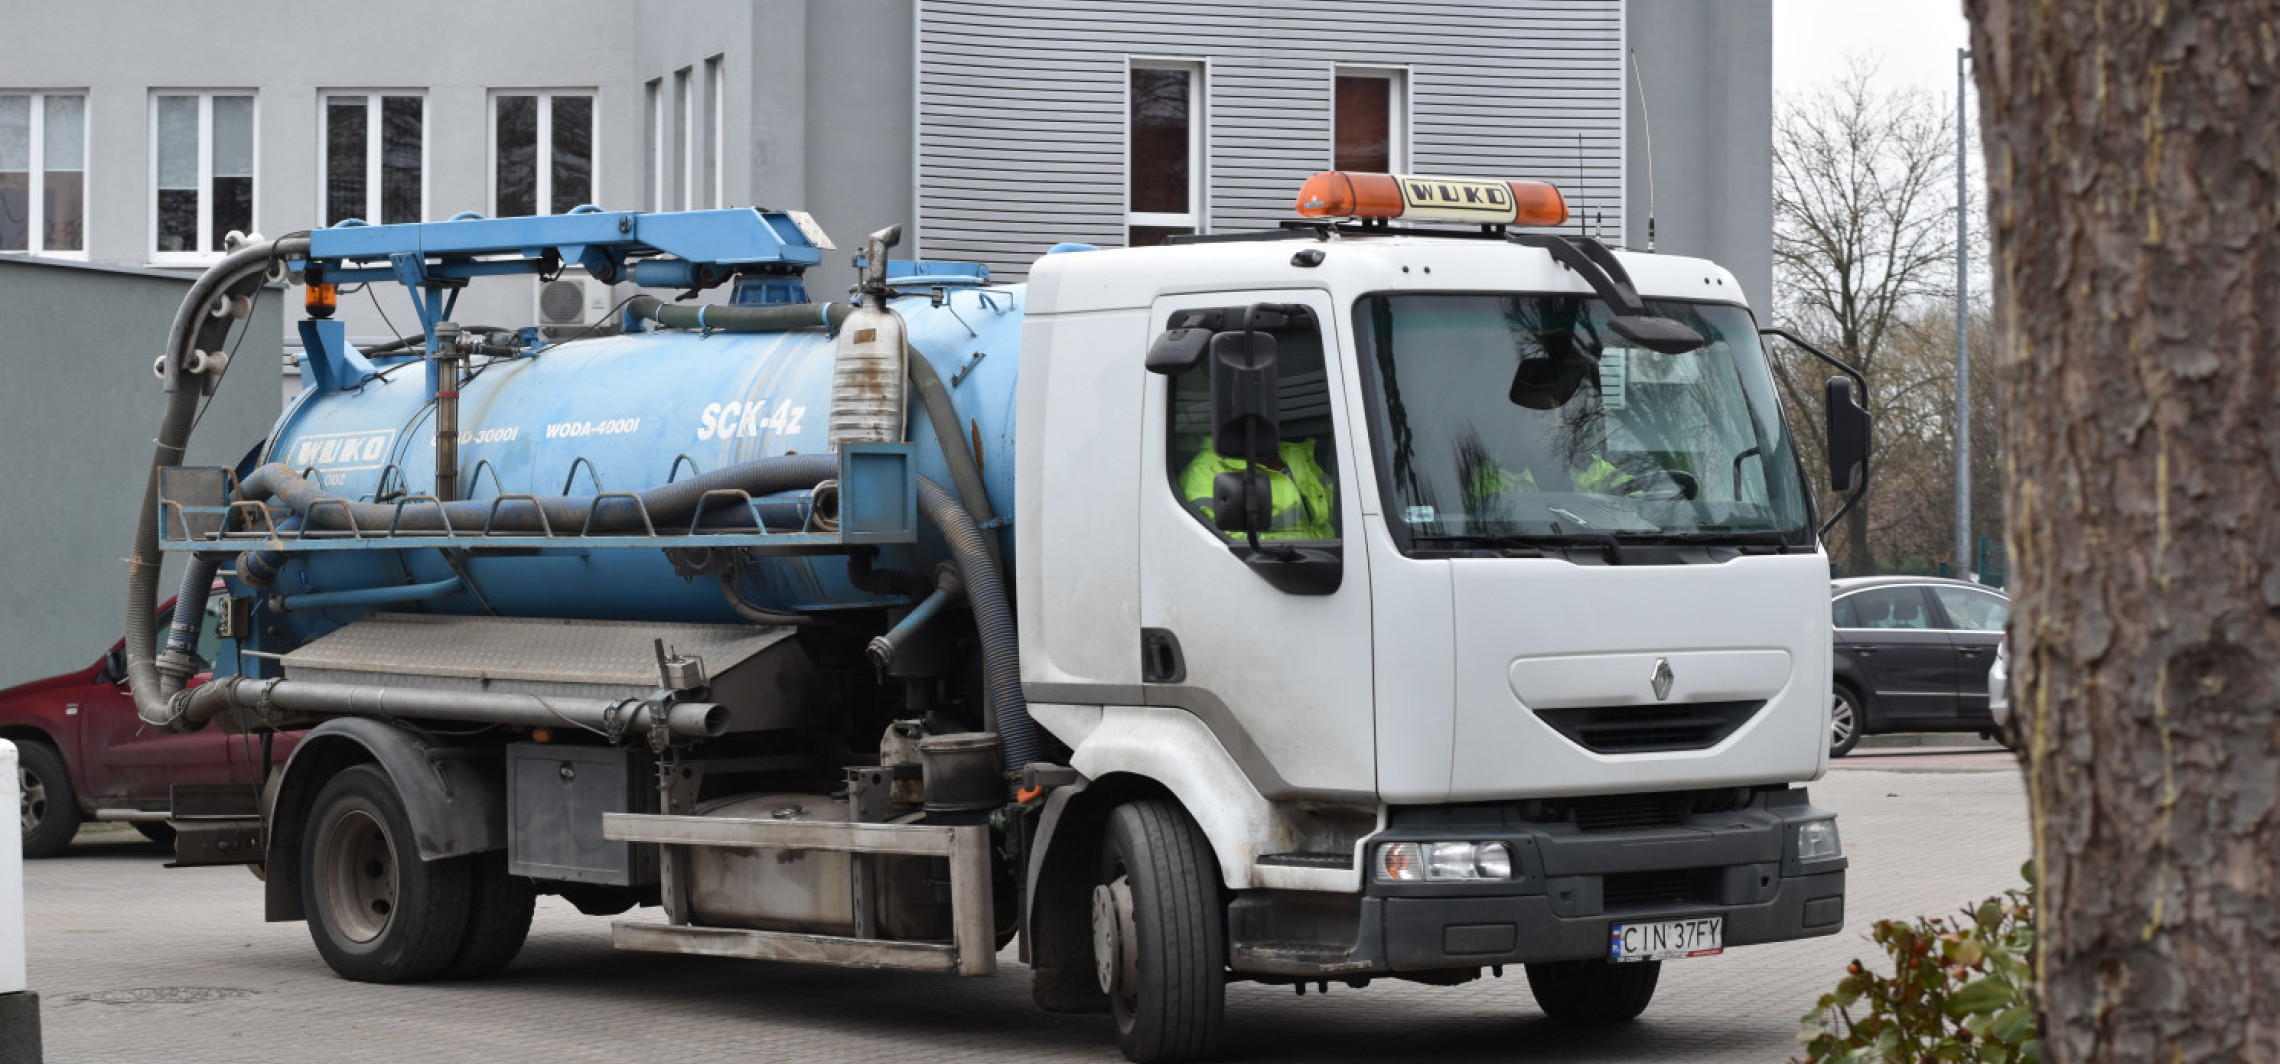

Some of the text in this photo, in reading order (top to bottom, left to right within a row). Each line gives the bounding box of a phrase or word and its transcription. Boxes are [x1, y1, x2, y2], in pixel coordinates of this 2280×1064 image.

[1410, 183, 1506, 205] WUKO
[296, 436, 386, 466] WUKO
[1624, 918, 1721, 953] CIN 37FY
